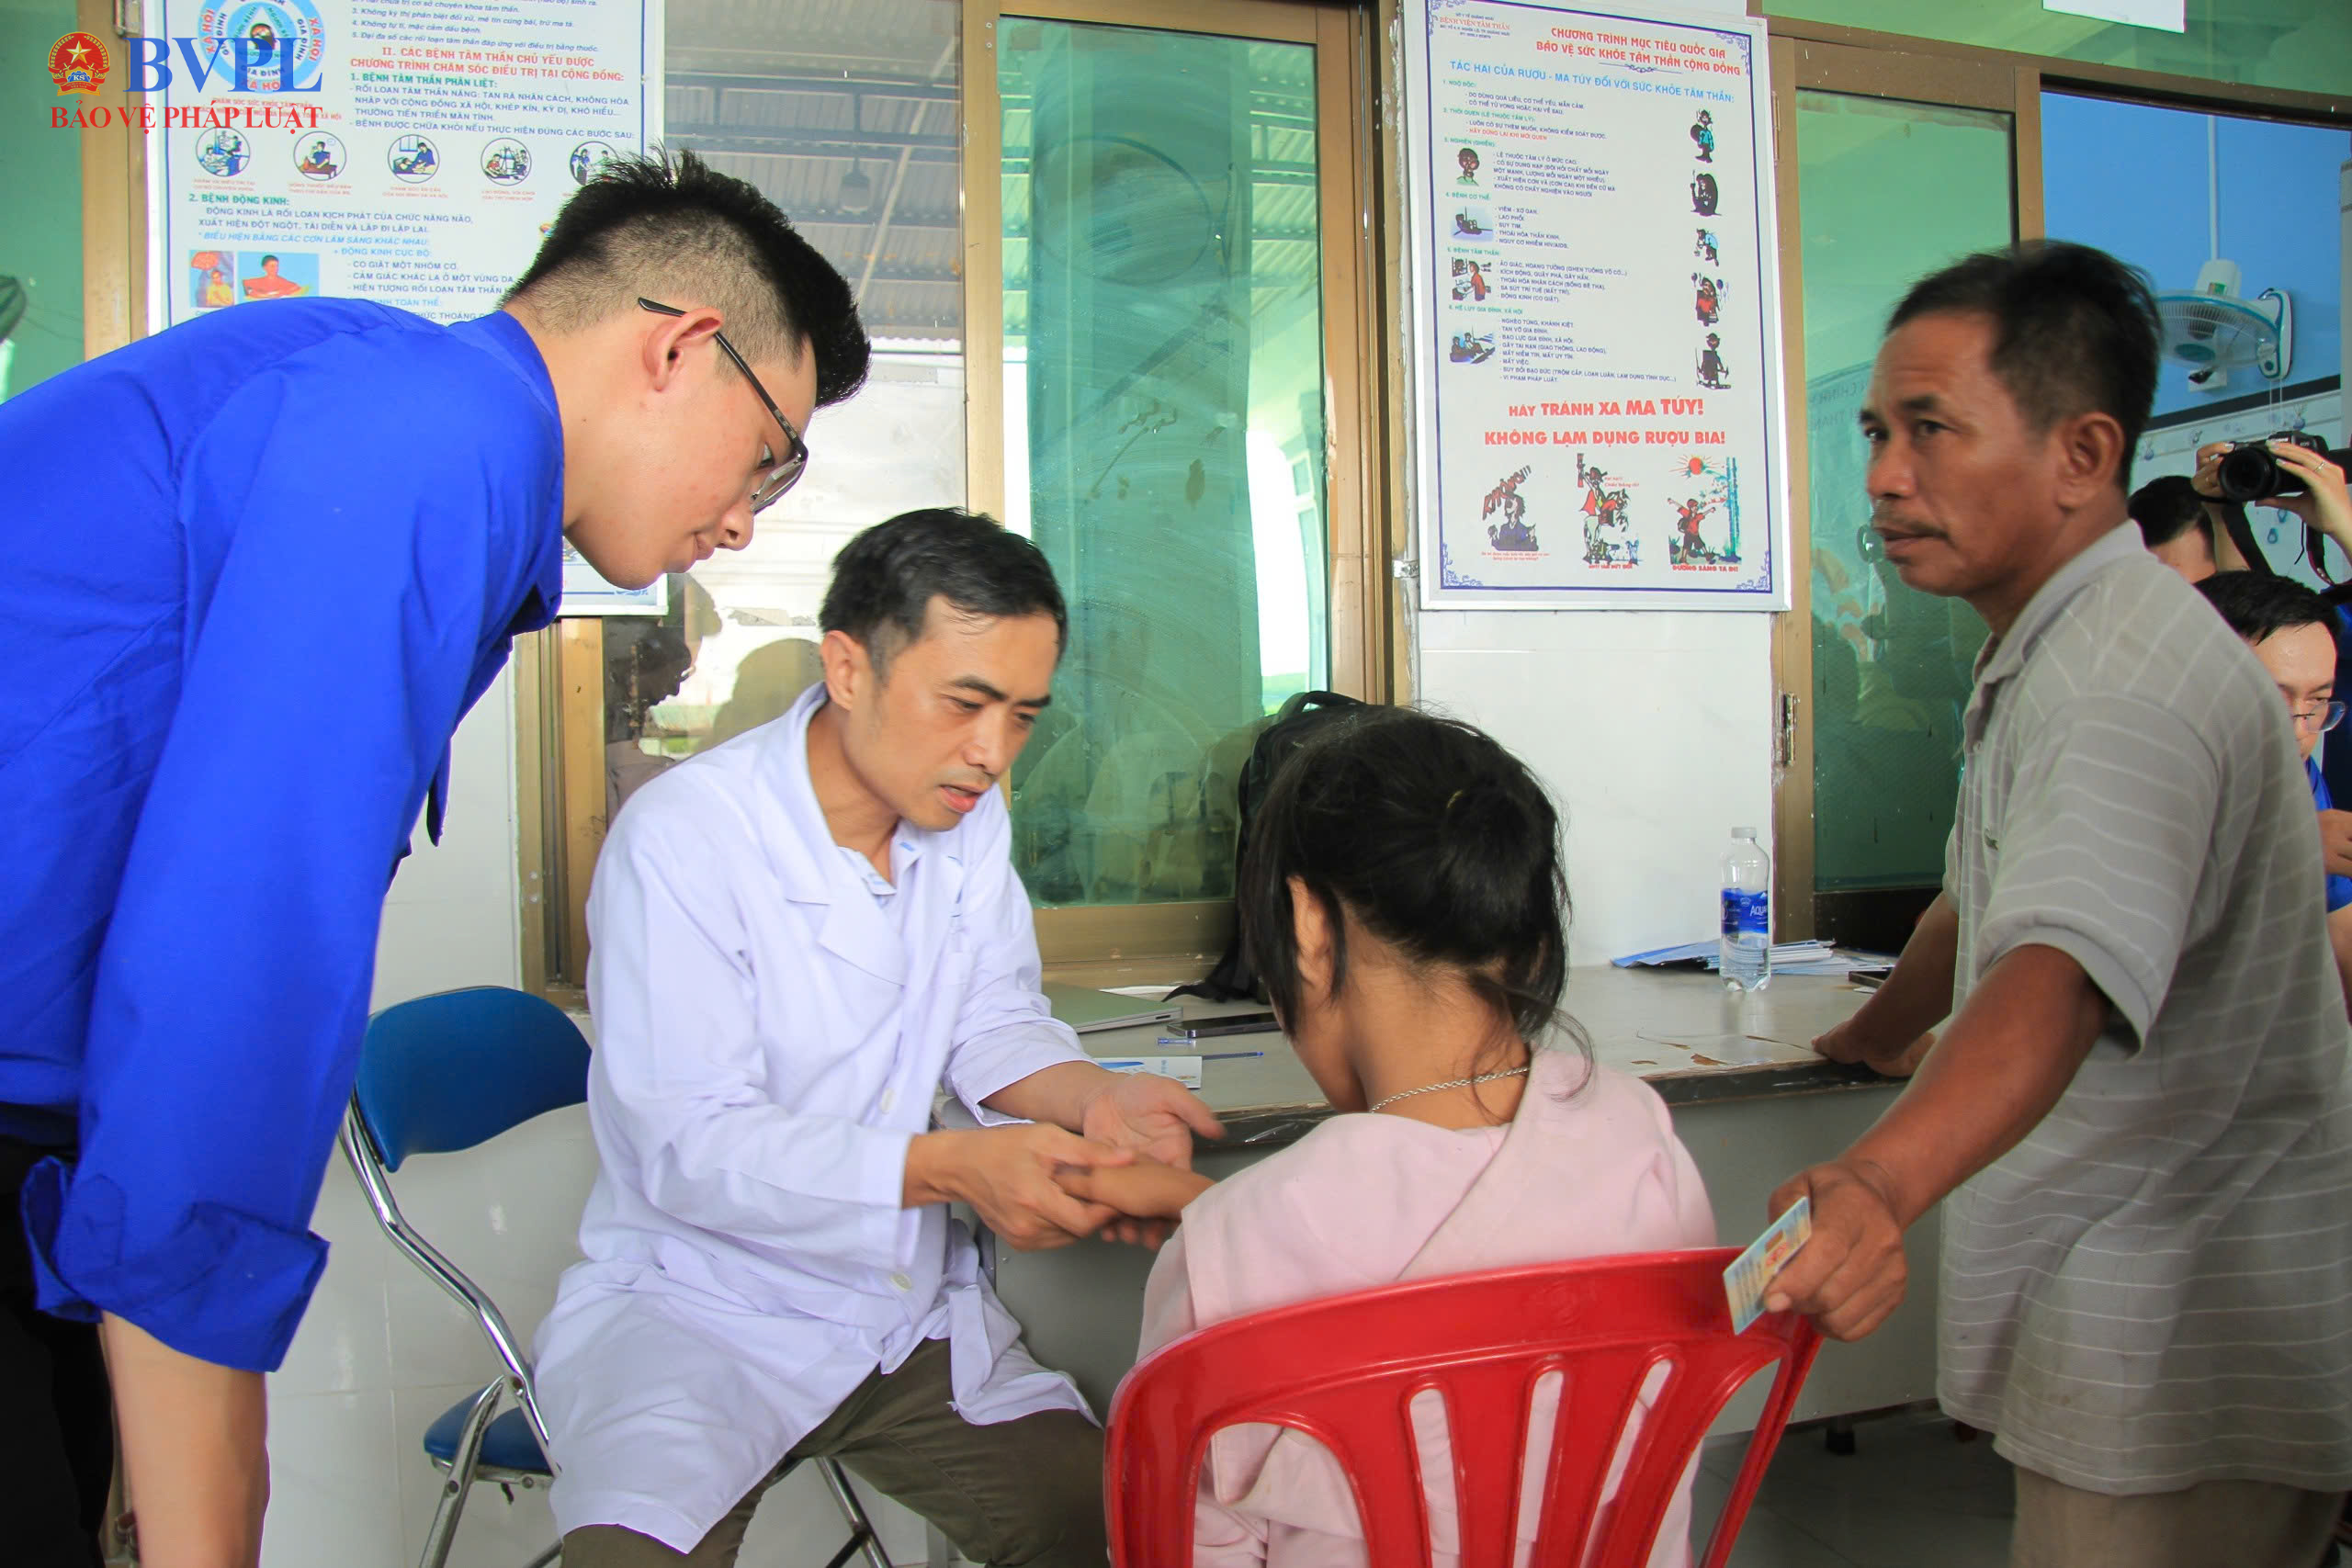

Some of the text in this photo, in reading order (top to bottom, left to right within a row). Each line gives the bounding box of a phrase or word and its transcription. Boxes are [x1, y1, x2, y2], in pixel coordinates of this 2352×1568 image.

[1551, 29, 1726, 59] CHƯƠNG TRÌNH MỤC TIÊU QUỐC GIA
[1536, 39, 1741, 75] BẢO VỆ SỨC KHỎE TÂM THẦN CỘNG ĐỒNG
[1541, 400, 1594, 416] TRÁNH
[1599, 401, 1621, 416] XA
[1625, 400, 1657, 415] MA
[1660, 395, 1703, 415] TÚY!
[1485, 429, 1725, 448] KHÔNG LẠM DỤNG RƯỢU BIA!
[1750, 905, 1767, 917] AQUA
